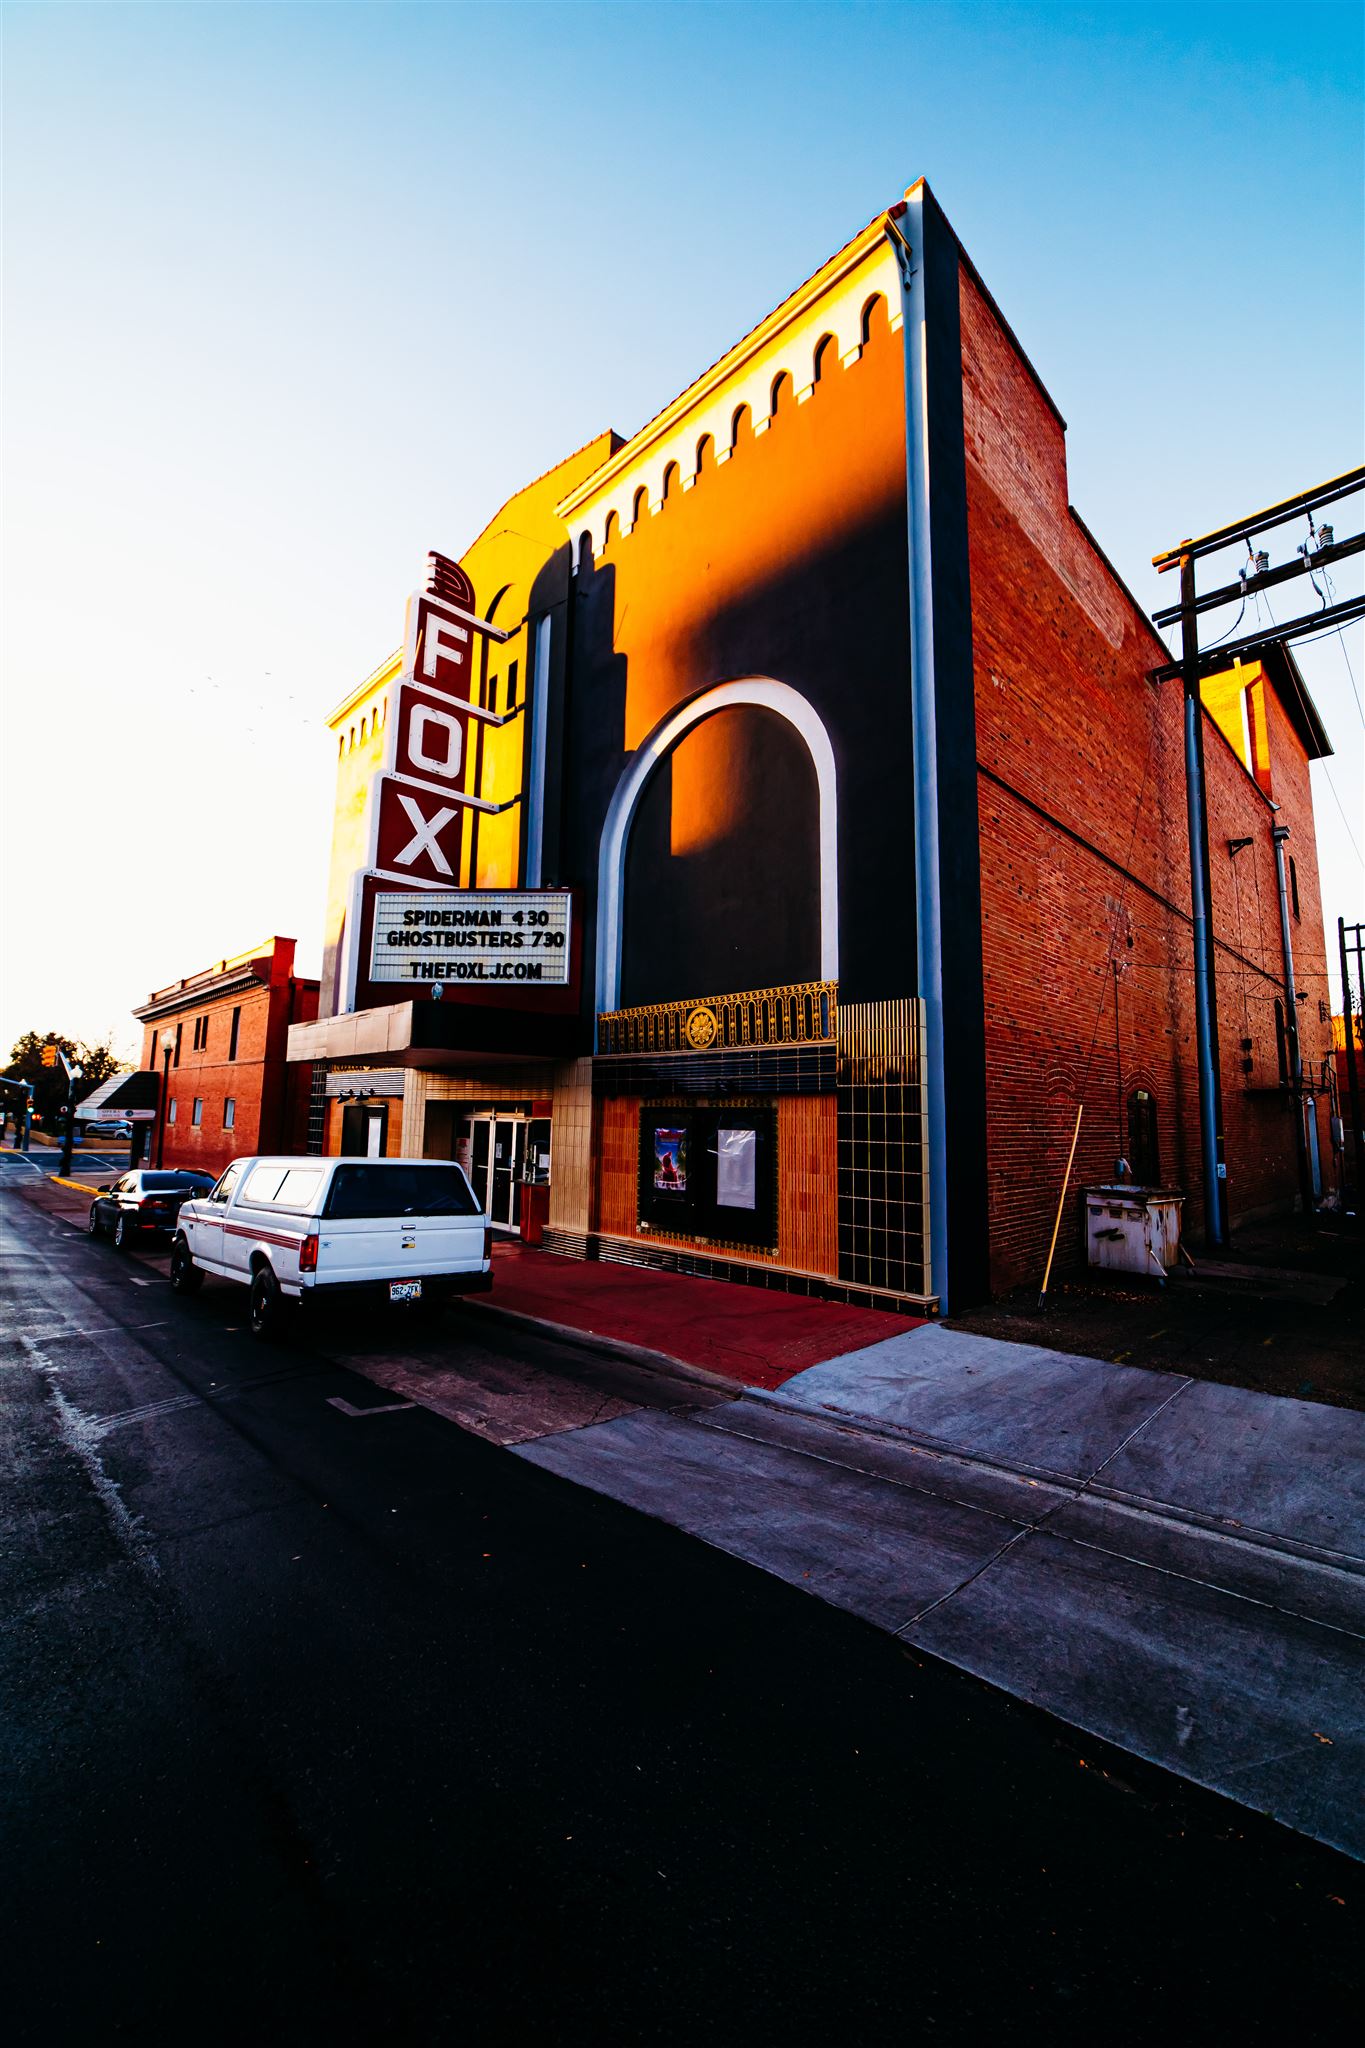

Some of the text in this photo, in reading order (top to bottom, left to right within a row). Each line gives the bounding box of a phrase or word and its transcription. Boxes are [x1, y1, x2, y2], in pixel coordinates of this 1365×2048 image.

[393, 612, 468, 876] FOX
[402, 910, 502, 926] SPIDERMAN
[387, 931, 565, 948] GHOSTBUSTERS 730
